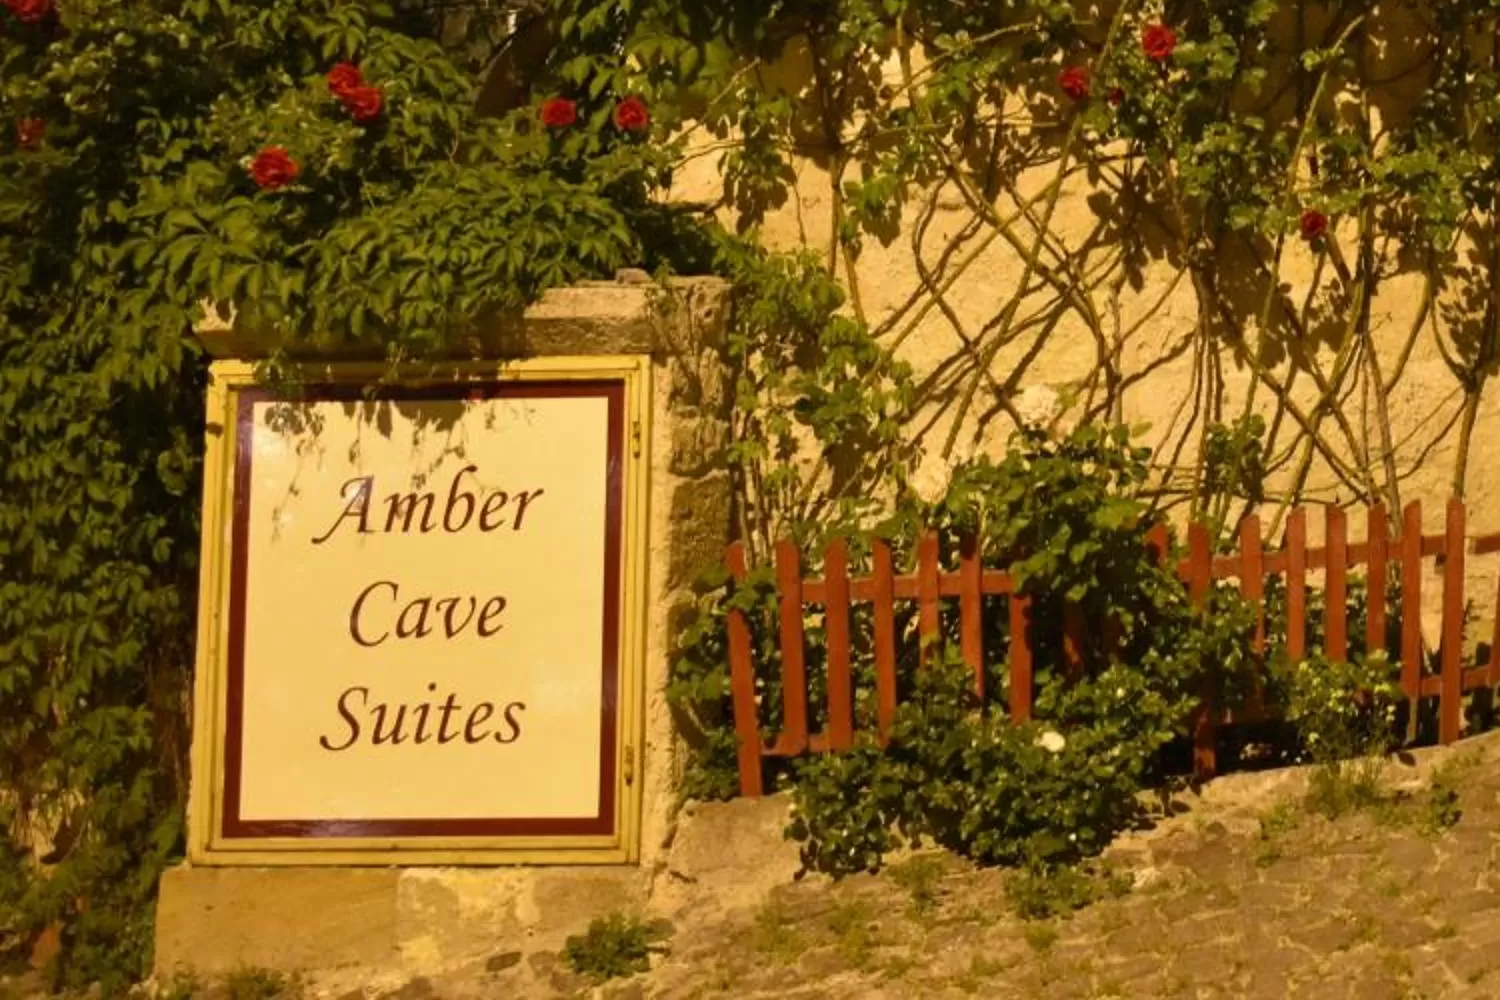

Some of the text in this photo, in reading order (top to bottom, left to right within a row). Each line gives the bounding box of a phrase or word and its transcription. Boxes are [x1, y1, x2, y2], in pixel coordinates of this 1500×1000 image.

[311, 464, 545, 544] Amber
[348, 580, 507, 648] Cave
[318, 681, 527, 752] Suites
